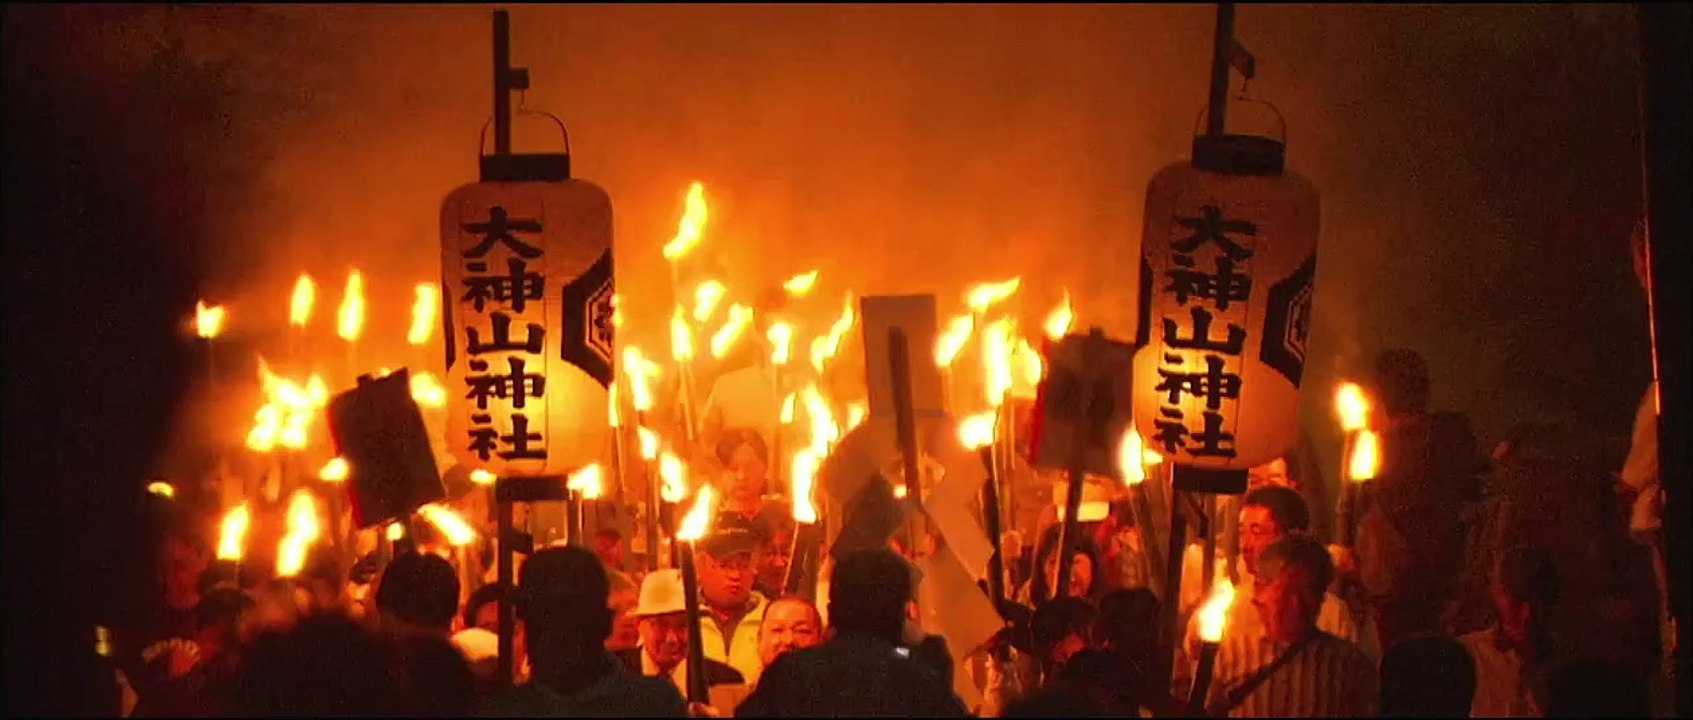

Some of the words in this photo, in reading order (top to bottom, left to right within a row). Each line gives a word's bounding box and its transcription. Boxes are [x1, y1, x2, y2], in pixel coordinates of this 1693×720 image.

[462, 206, 547, 461] 大神山神社
[1154, 206, 1257, 458] 大神山神社
